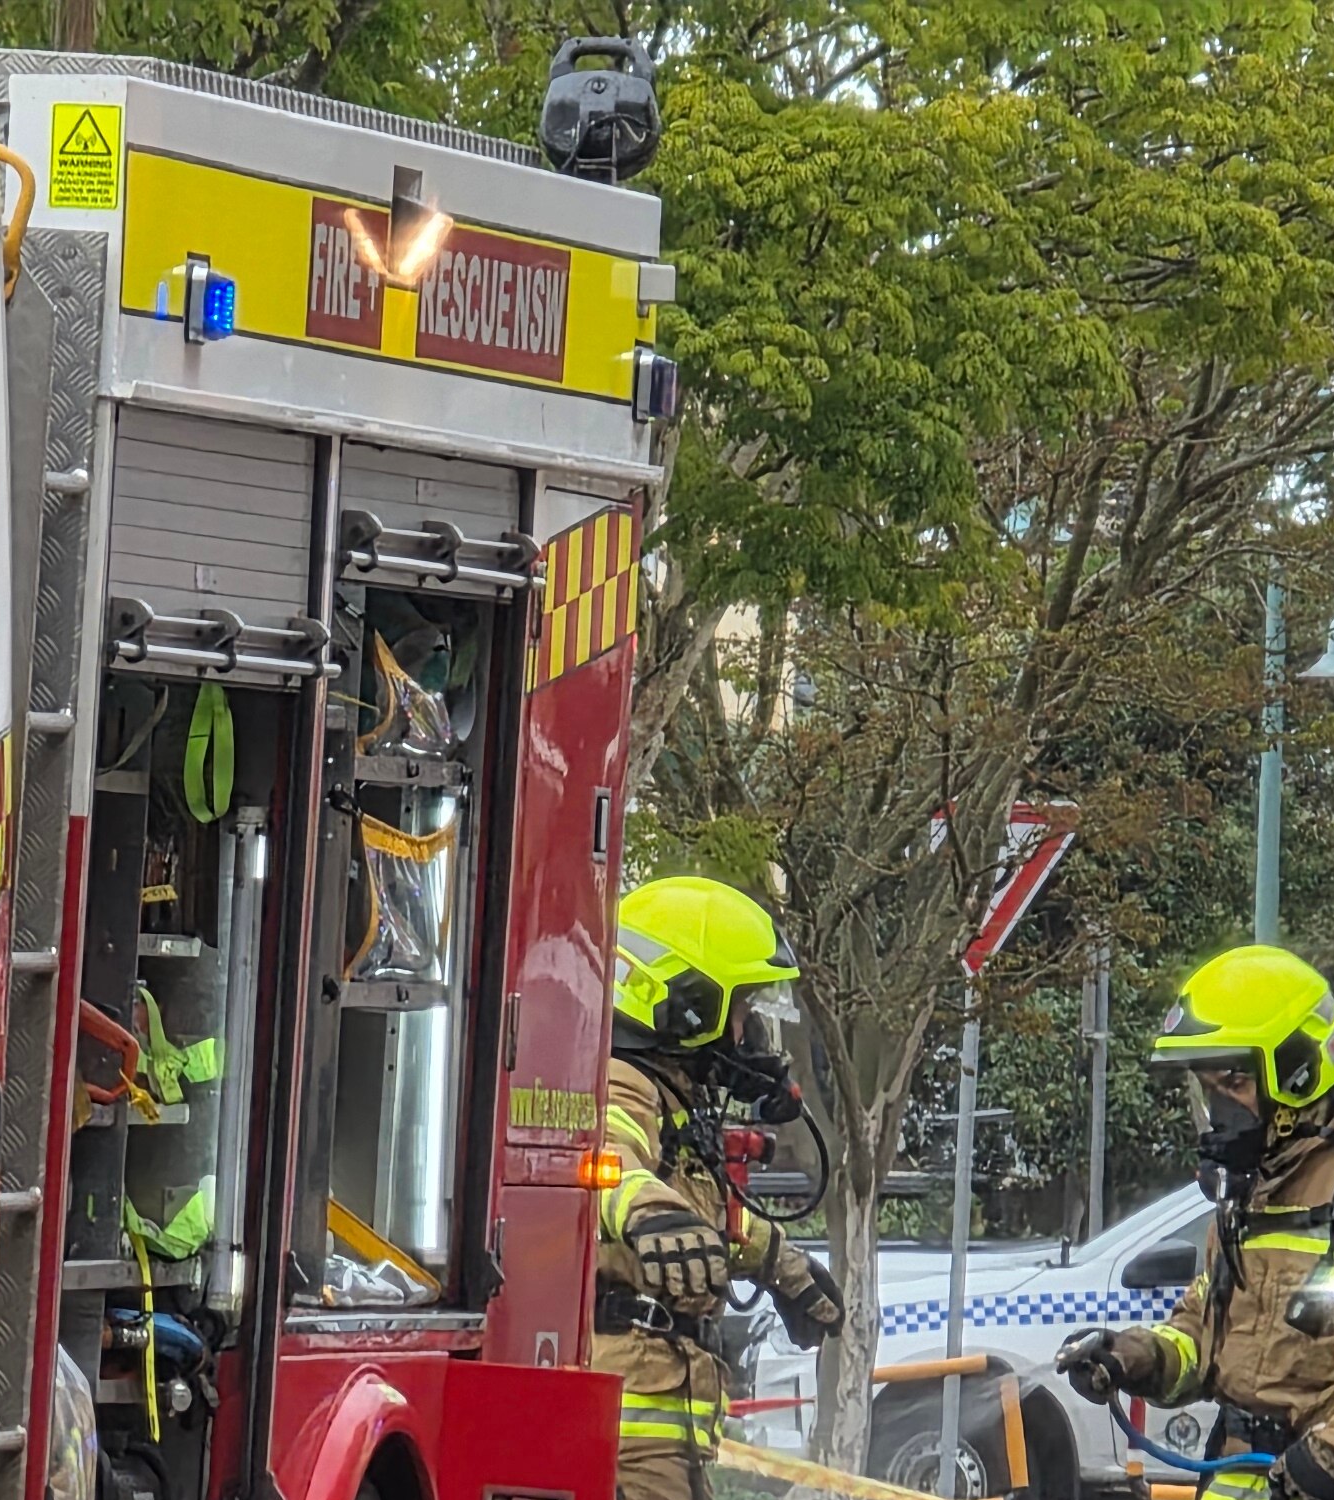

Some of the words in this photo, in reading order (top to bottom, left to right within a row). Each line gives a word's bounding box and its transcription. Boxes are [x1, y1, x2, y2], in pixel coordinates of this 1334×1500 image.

[310, 223, 362, 320] FIRE
[420, 247, 513, 348] RESCUE
[512, 263, 568, 357] NSW
